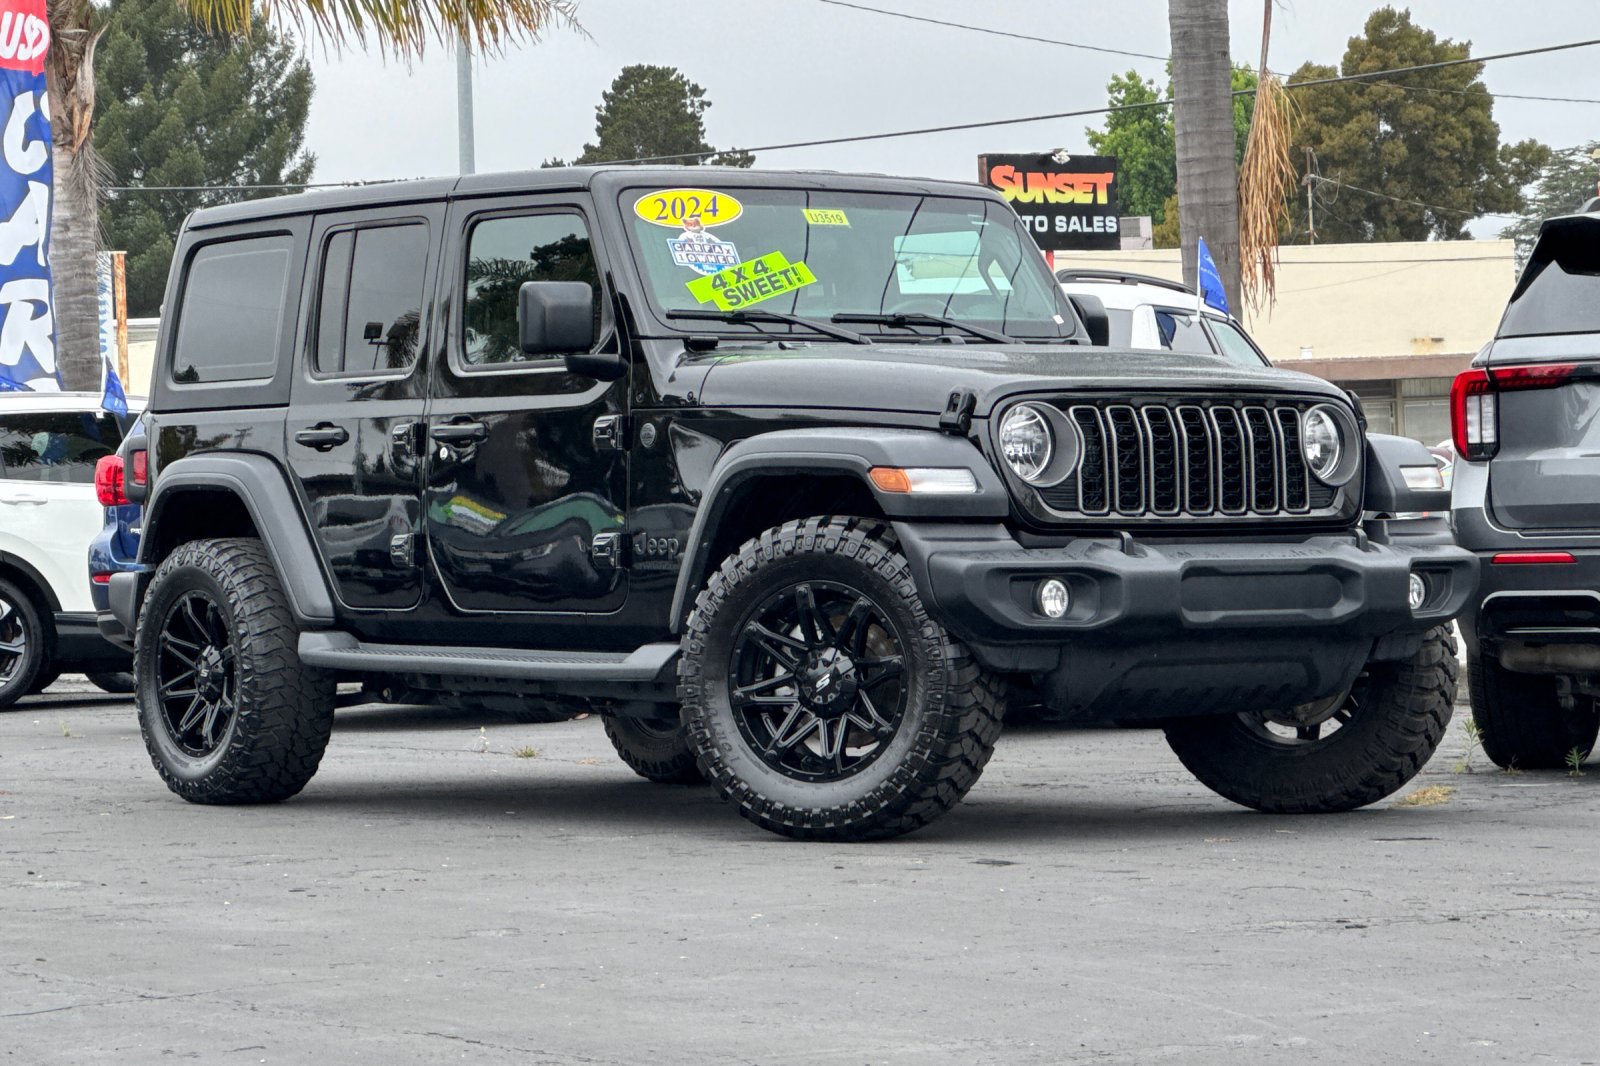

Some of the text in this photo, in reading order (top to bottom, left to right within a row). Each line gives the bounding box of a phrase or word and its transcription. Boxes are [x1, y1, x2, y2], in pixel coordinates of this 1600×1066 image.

[990, 165, 1114, 204] SUNSET
[653, 195, 719, 220] 2024
[809, 213, 845, 224] U3519
[1055, 215, 1118, 233] SALES
[674, 243, 731, 255] CARFAX
[687, 255, 735, 264] OWNER
[711, 273, 729, 291] 4
[753, 258, 770, 275] 4
[723, 266, 804, 307] SWEET!
[634, 532, 680, 561] Jeep
